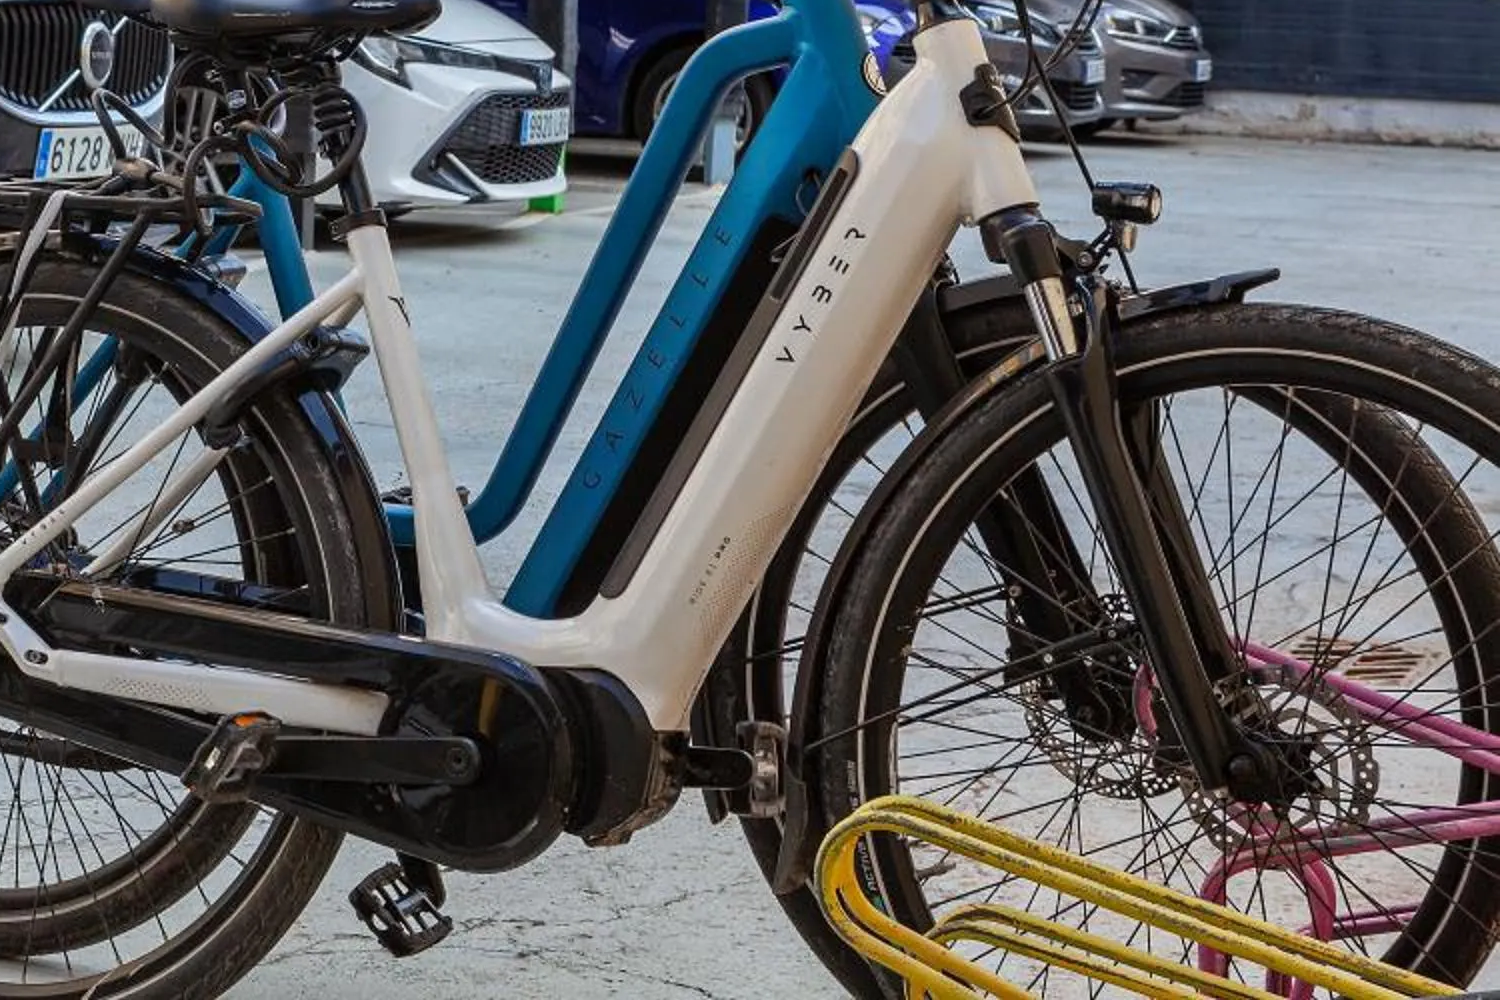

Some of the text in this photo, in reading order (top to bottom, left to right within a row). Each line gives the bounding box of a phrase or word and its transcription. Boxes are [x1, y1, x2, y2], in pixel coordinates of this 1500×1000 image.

[51, 135, 104, 173] 6128
[583, 226, 733, 489] GAZELLE
[775, 227, 867, 363] VYBER
